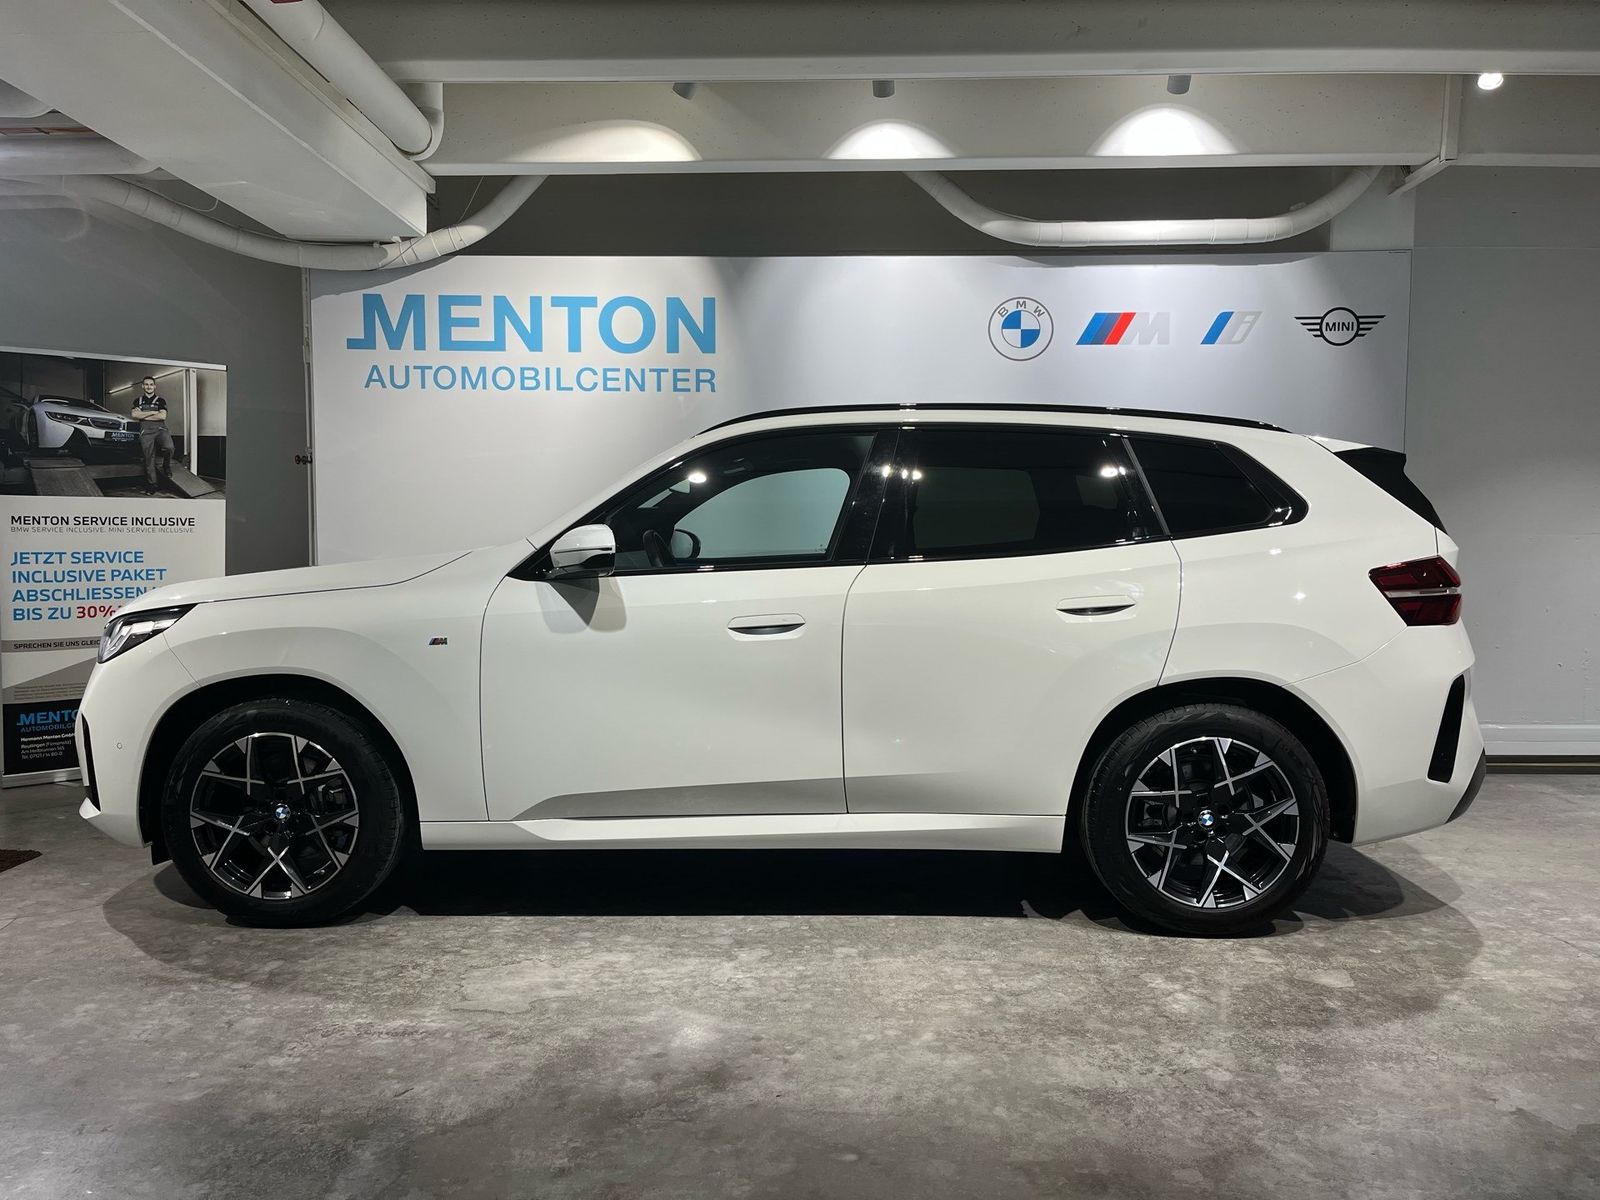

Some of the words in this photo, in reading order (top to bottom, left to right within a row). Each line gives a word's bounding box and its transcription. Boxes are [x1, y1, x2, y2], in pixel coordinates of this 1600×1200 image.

[346, 293, 716, 354] MENTON
[1325, 321, 1354, 332] MINI
[364, 364, 716, 392] AUTOMOBILCENTER
[11, 515, 69, 526] MENTON
[73, 516, 128, 526] SERVICE
[131, 517, 195, 527] INCLUSIVE
[11, 552, 67, 566] JETZT
[70, 551, 144, 564] SERVICE
[12, 569, 106, 583] INCLUSIVE
[111, 568, 167, 581] PAKET
[12, 586, 147, 602] ABSCHLIESSEN
[13, 607, 42, 621] BIS
[48, 607, 72, 620] ZU
[14, 642, 52, 650] SPRECHEN
